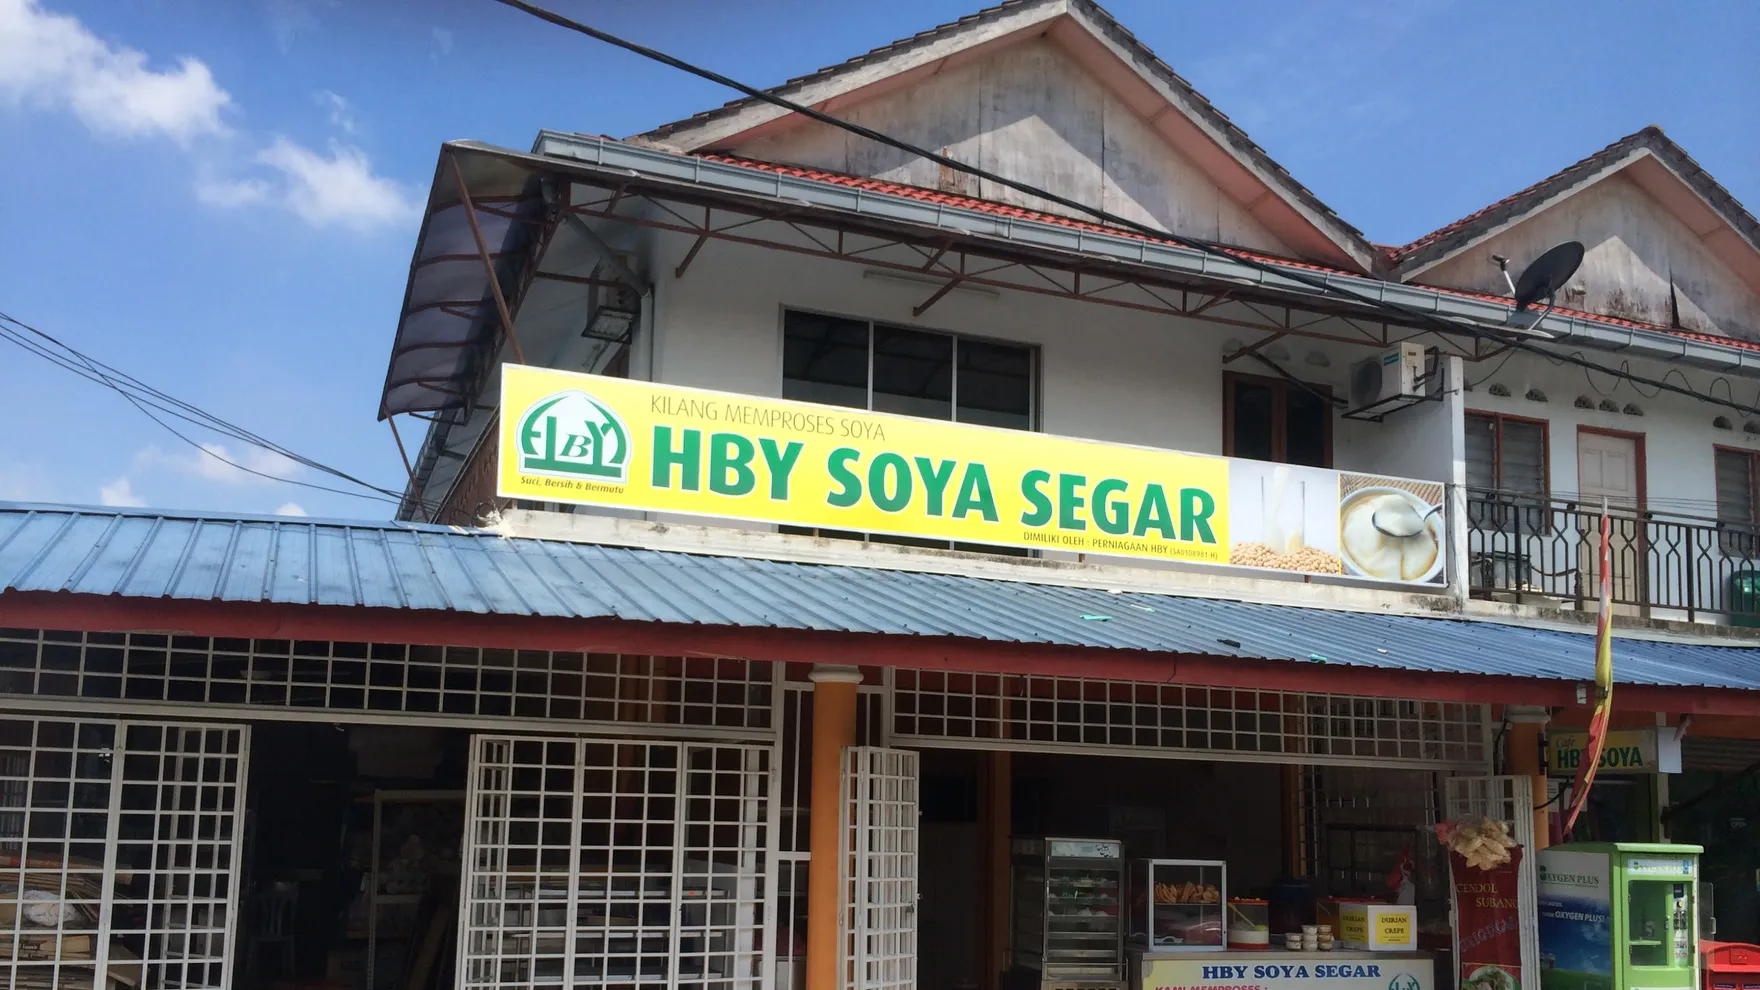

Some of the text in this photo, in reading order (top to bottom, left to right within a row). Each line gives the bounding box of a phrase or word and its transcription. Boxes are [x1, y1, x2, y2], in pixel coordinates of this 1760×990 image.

[650, 394, 886, 442] KILANG MEMPROSES SOYA
[520, 476, 624, 494] Suci, Bersih & Bermutu
[651, 425, 1218, 545] HBY SOYA SEGAR
[1023, 531, 1060, 544] DIMILIKI
[1062, 535, 1085, 546] OLEH
[1092, 539, 1149, 552] PERNIAGAAN
[1150, 543, 1168, 554] HBY
[1557, 749, 1584, 769] HB
[1456, 884, 1498, 894] CENDOL
[1577, 875, 1599, 885] PLUS
[1555, 910, 1584, 921] OXYGEN
[1584, 913, 1605, 923] PLUS!
[1202, 964, 1381, 979] HBY SOYA SEGAR
